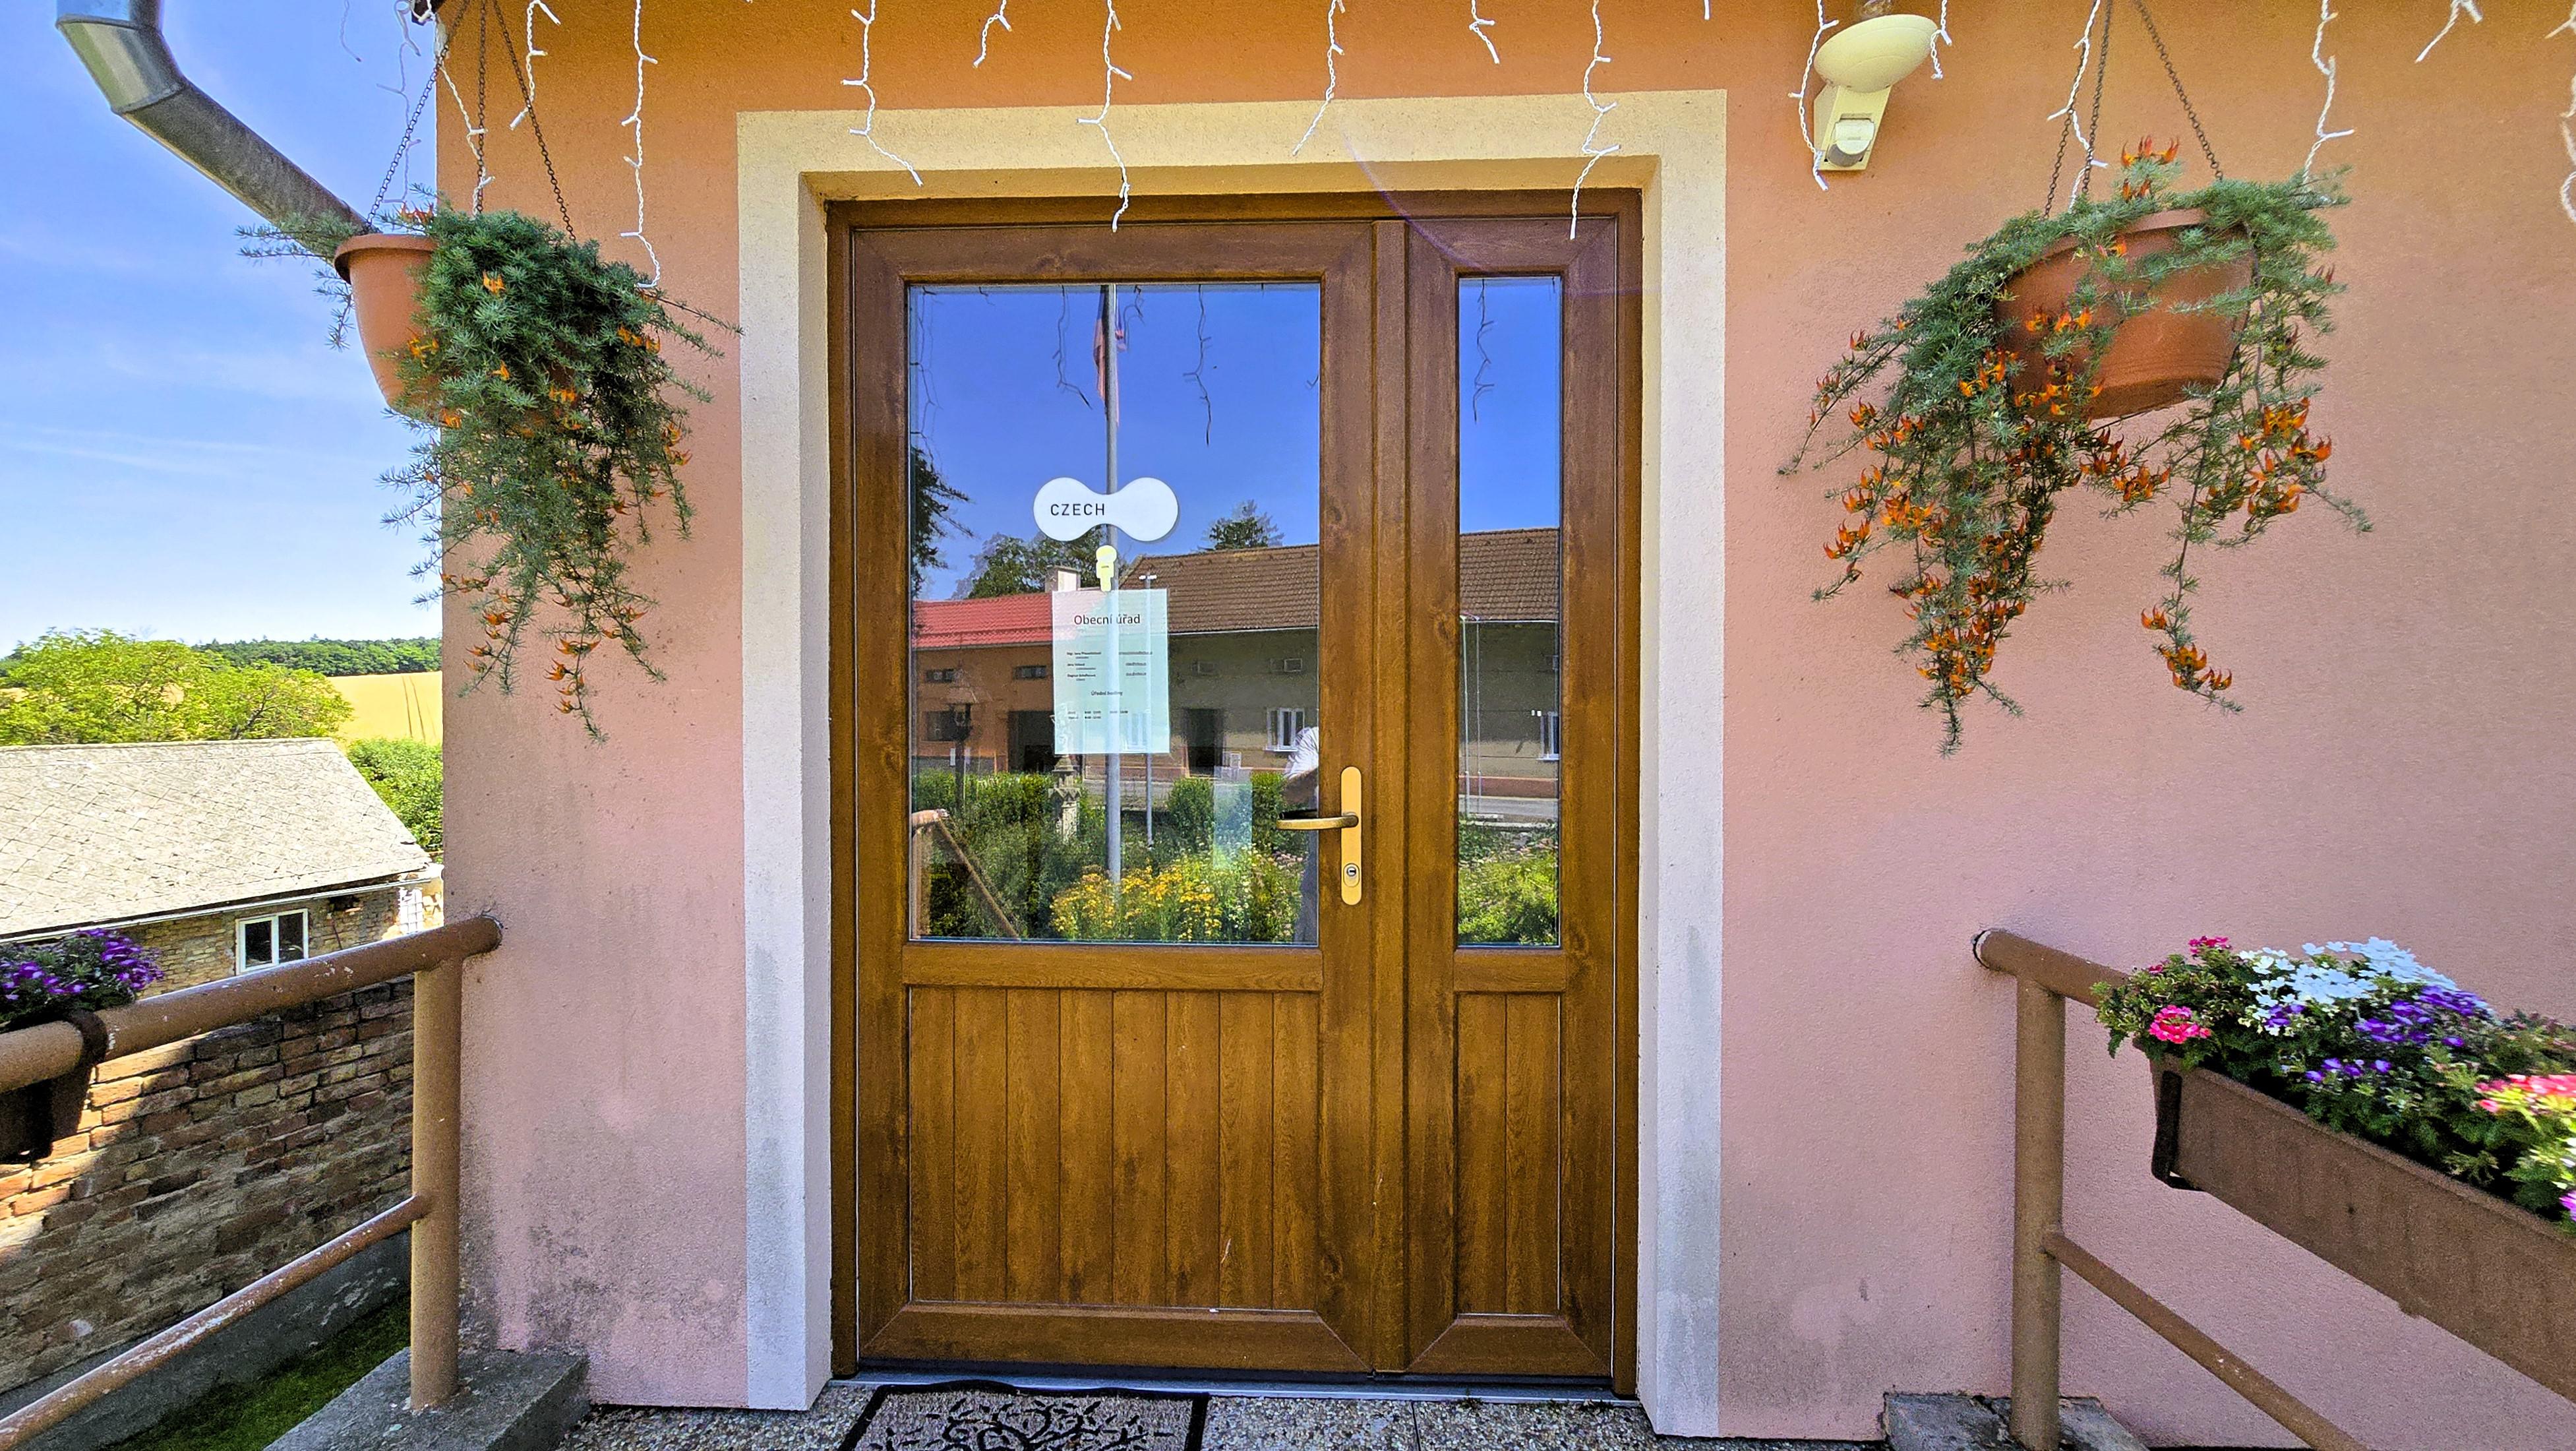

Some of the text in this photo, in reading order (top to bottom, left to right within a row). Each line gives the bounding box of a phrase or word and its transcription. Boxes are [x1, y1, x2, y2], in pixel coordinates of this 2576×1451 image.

[1050, 503, 1105, 516] CZECH
[1074, 613, 1141, 625] Obecní úřad
